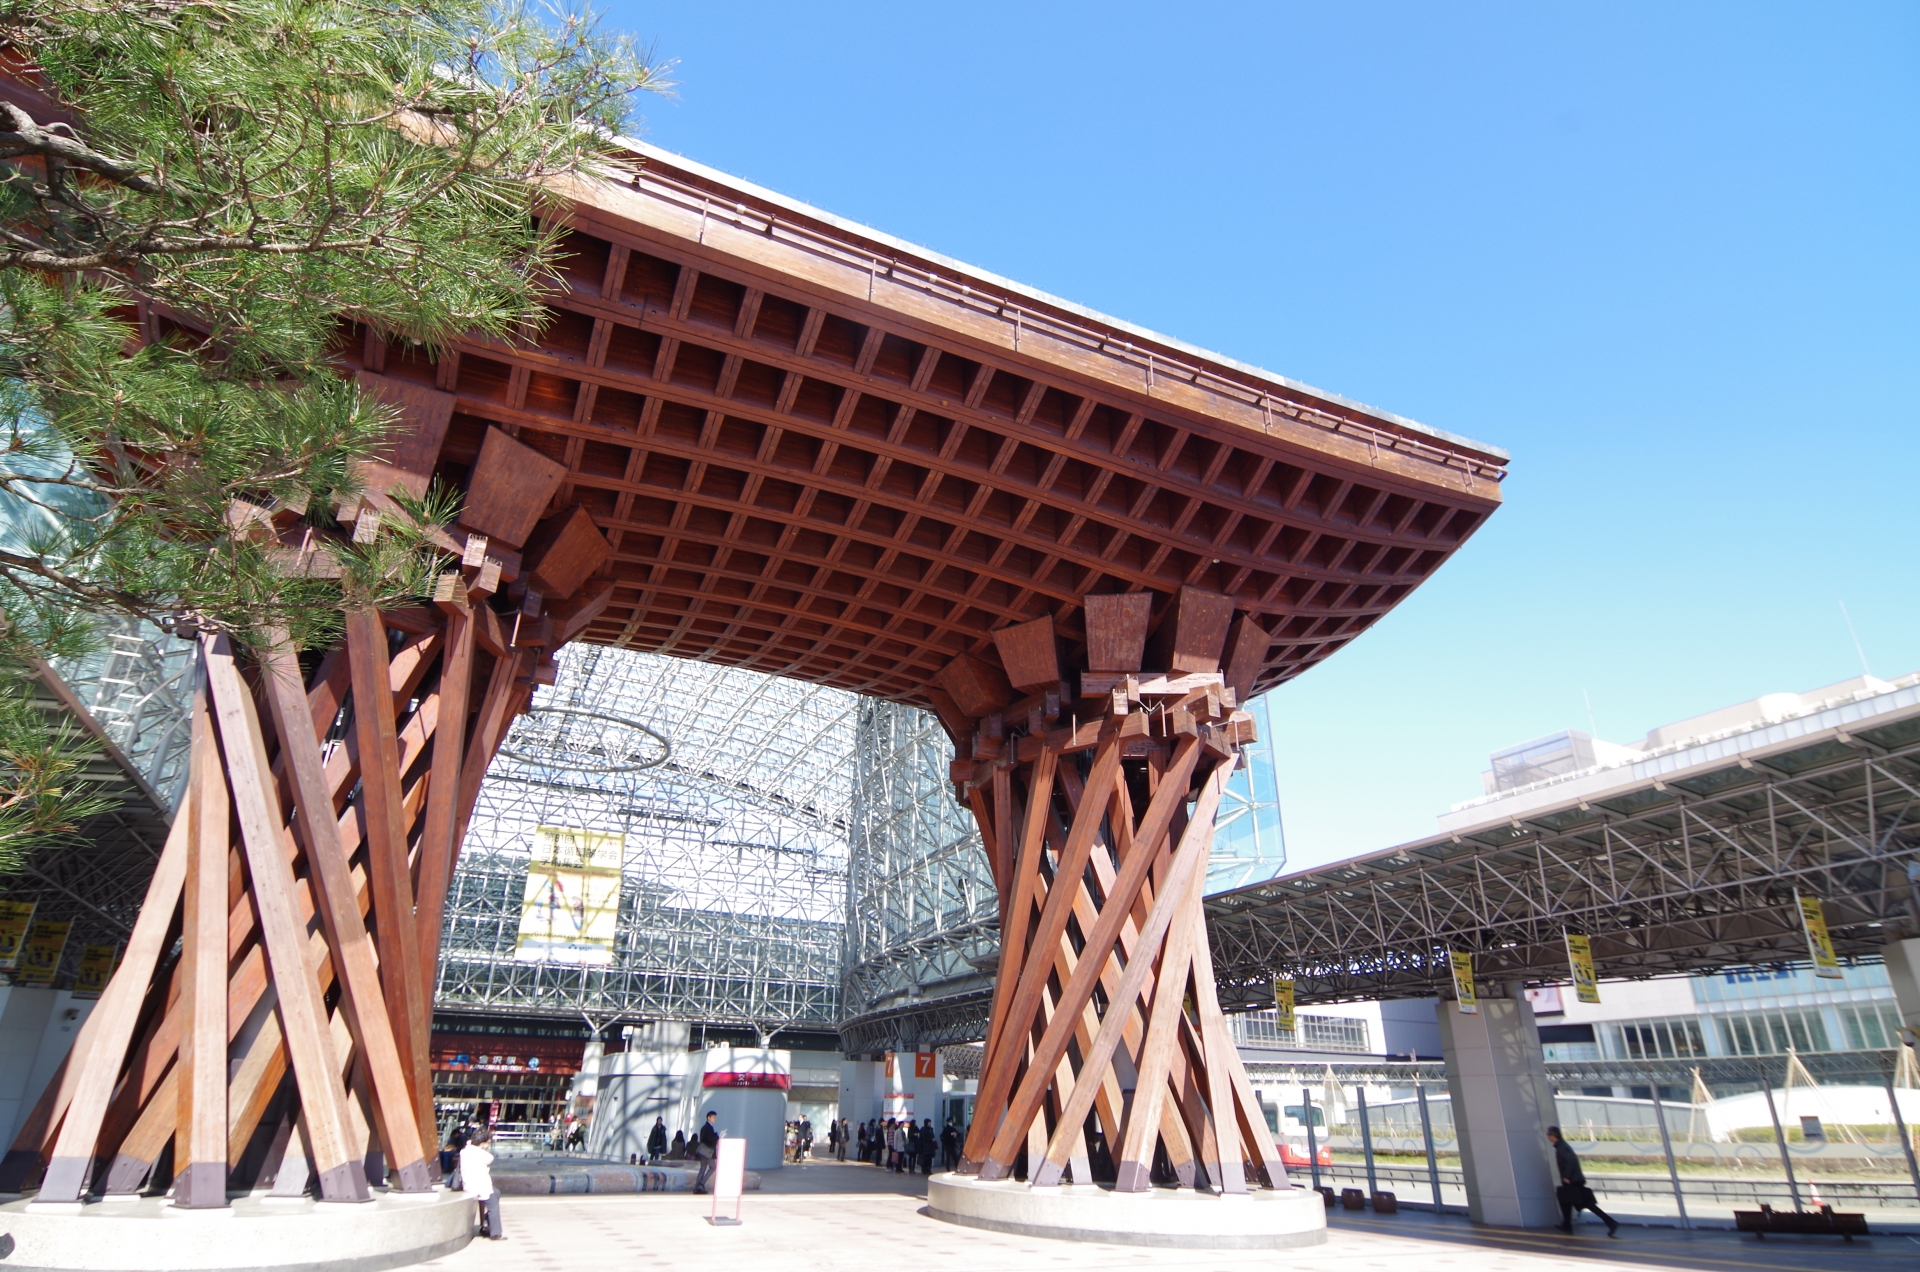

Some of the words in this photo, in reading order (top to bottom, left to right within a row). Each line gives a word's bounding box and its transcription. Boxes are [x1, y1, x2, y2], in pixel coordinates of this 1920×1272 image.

[449, 1053, 470, 1066] JR
[479, 1055, 517, 1065] 金沢駅
[887, 1057, 893, 1074] 7
[920, 1057, 931, 1075] 7
